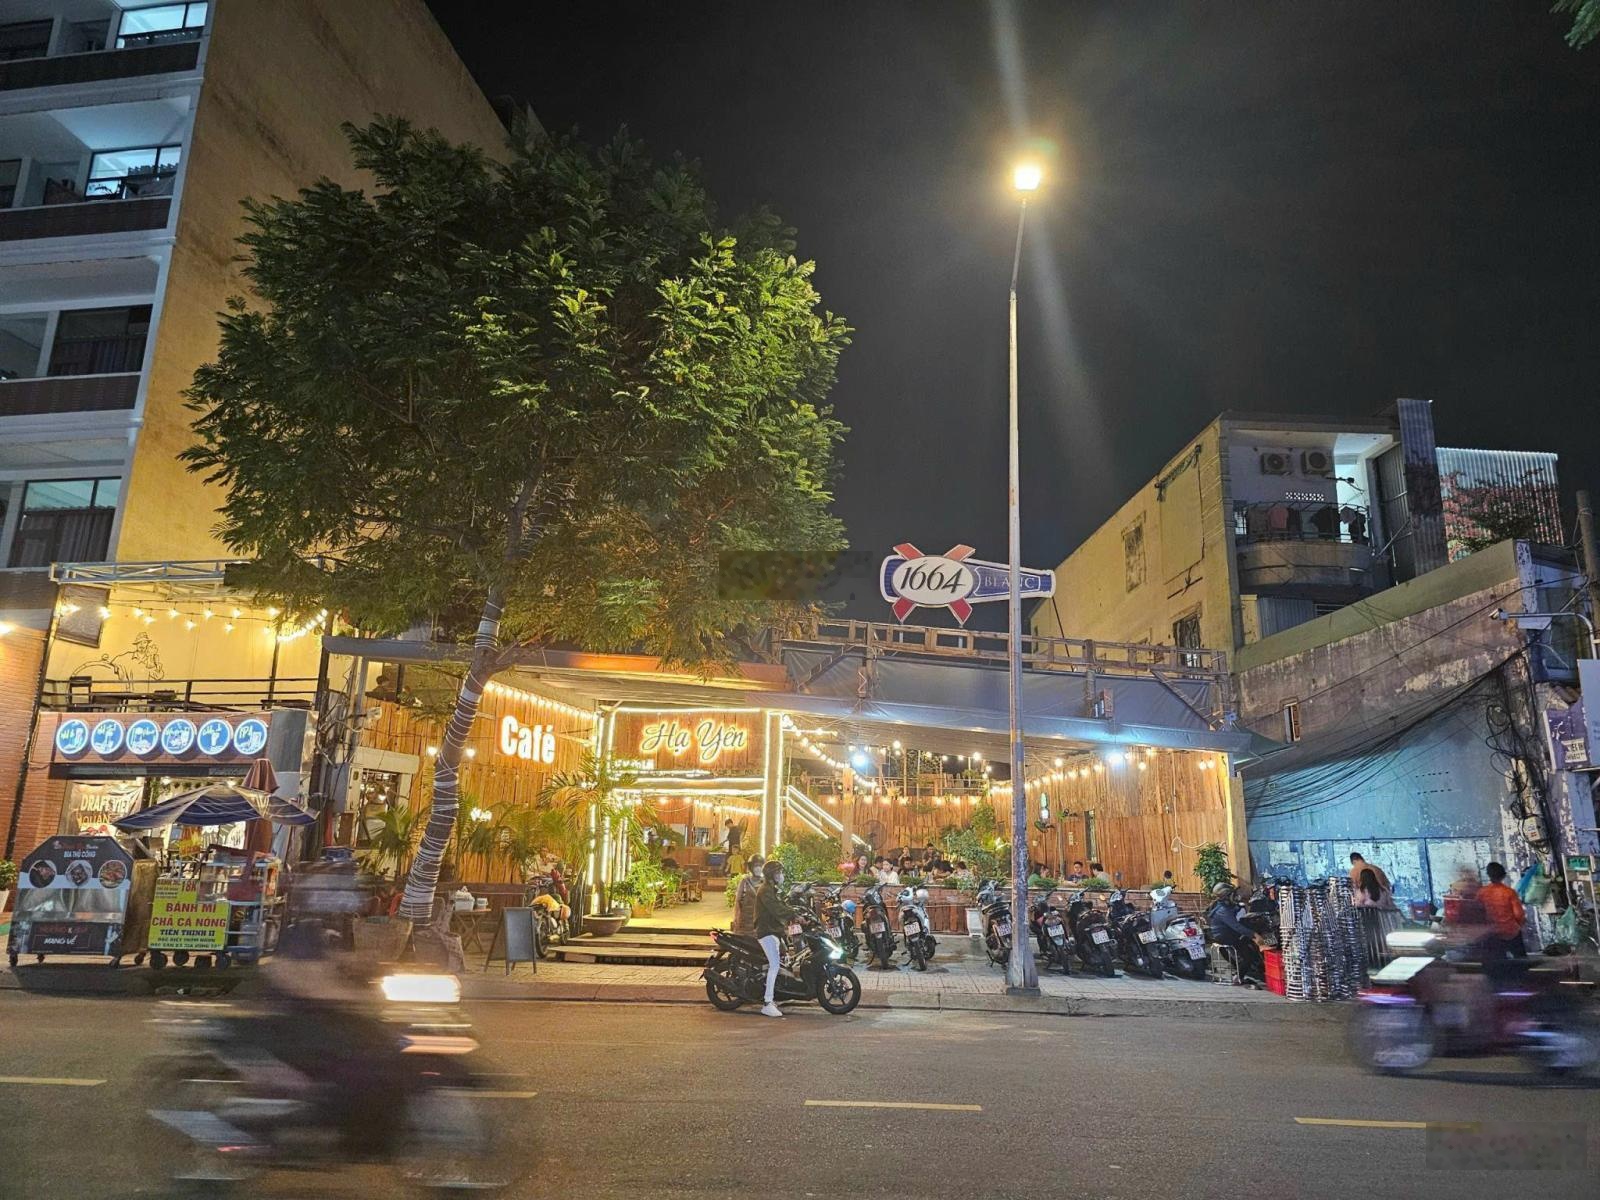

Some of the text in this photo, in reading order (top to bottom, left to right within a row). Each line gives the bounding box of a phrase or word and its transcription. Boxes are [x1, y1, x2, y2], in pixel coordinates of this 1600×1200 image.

[901, 560, 966, 593] 1664
[501, 715, 556, 764] Café
[641, 720, 746, 761] Hạ Yên
